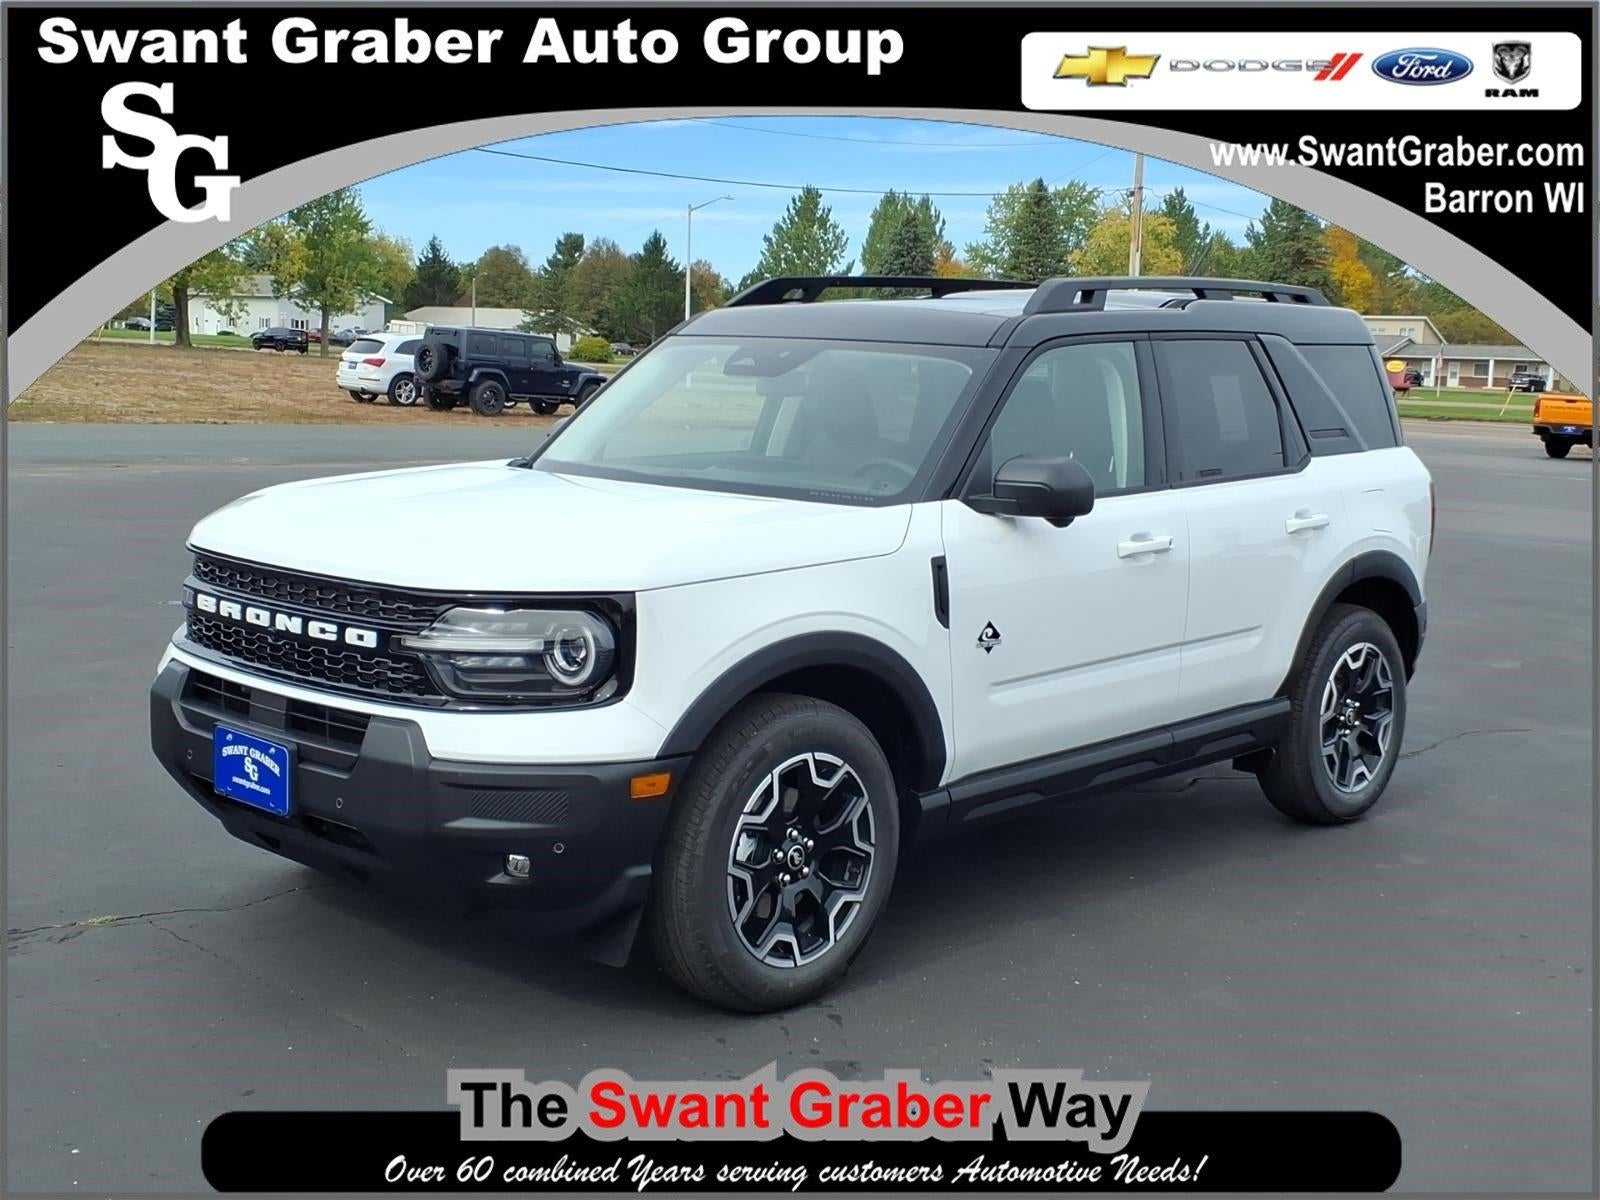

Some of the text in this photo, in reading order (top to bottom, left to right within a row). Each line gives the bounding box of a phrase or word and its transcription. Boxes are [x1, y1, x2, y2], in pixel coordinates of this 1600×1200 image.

[196, 593, 378, 648] BRONCO
[221, 744, 281, 777] SWANT GRABER
[244, 756, 259, 782] SG
